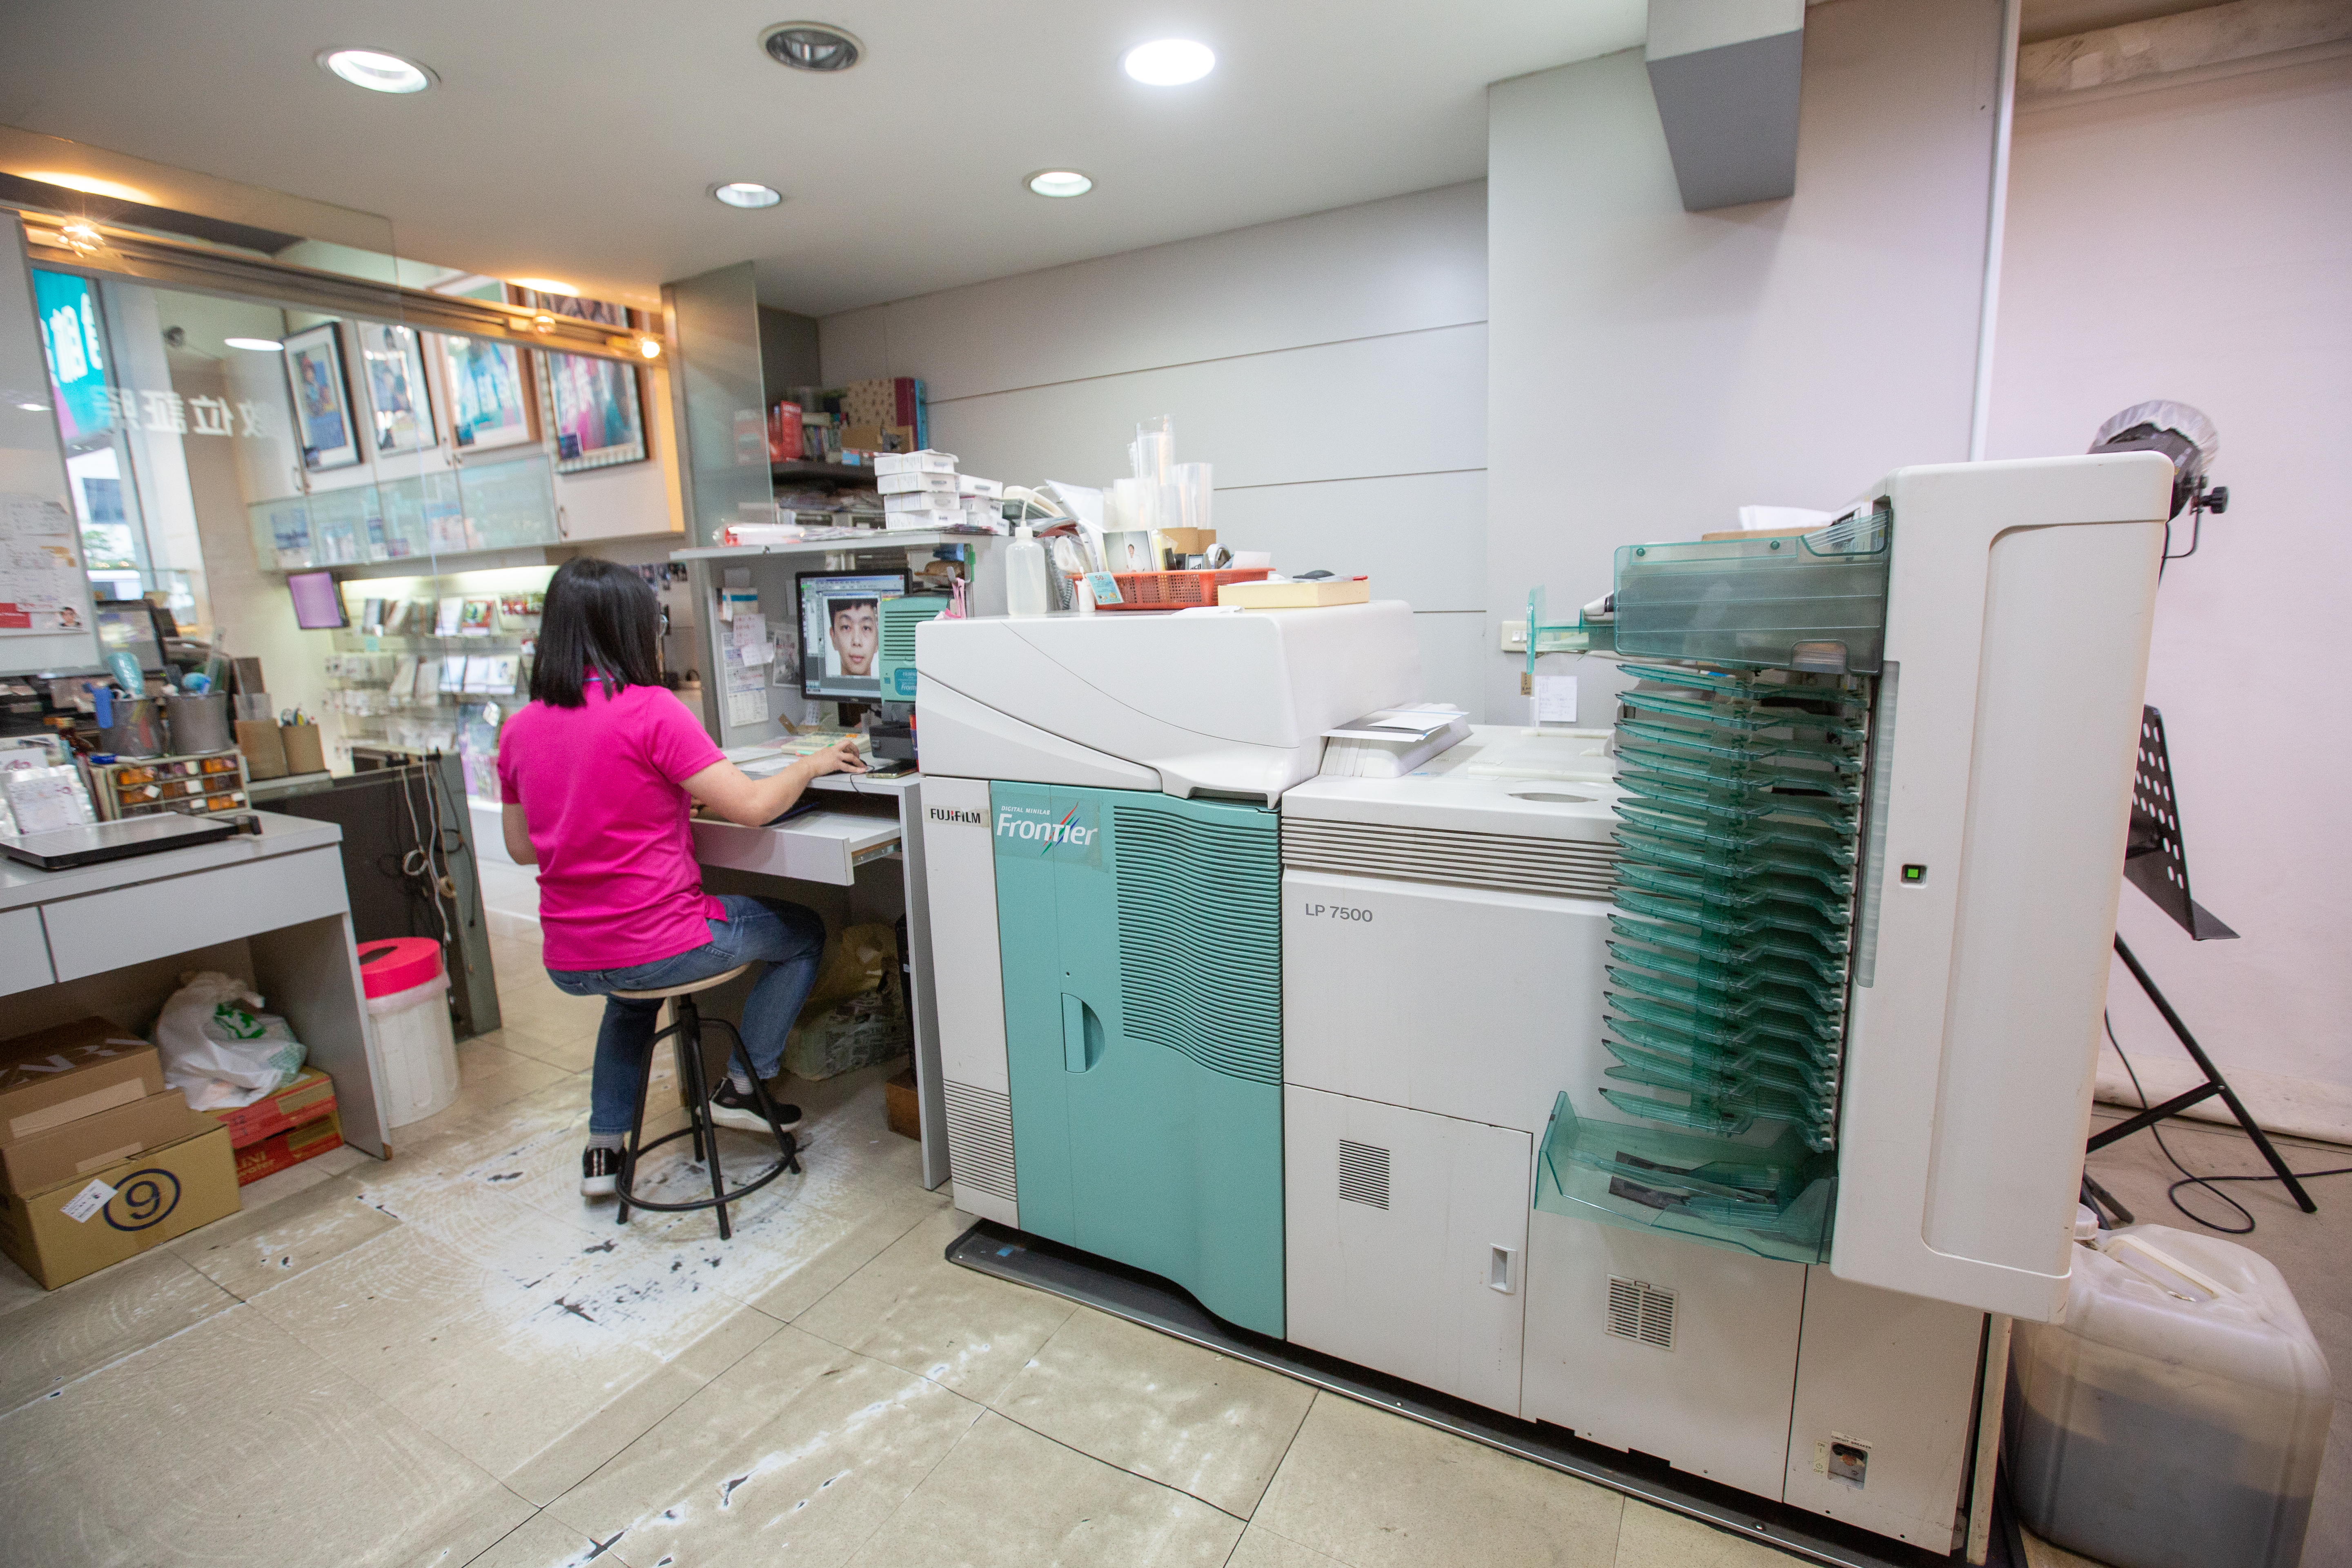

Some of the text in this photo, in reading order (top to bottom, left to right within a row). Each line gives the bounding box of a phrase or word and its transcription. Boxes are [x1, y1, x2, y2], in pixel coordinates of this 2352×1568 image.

[931, 808, 981, 824] FUJIFILM
[996, 813, 1098, 846] Frontier
[1305, 903, 1373, 922] LP 7500
[125, 1180, 160, 1220] 9
[1851, 1441, 1871, 1449] BREAKER
